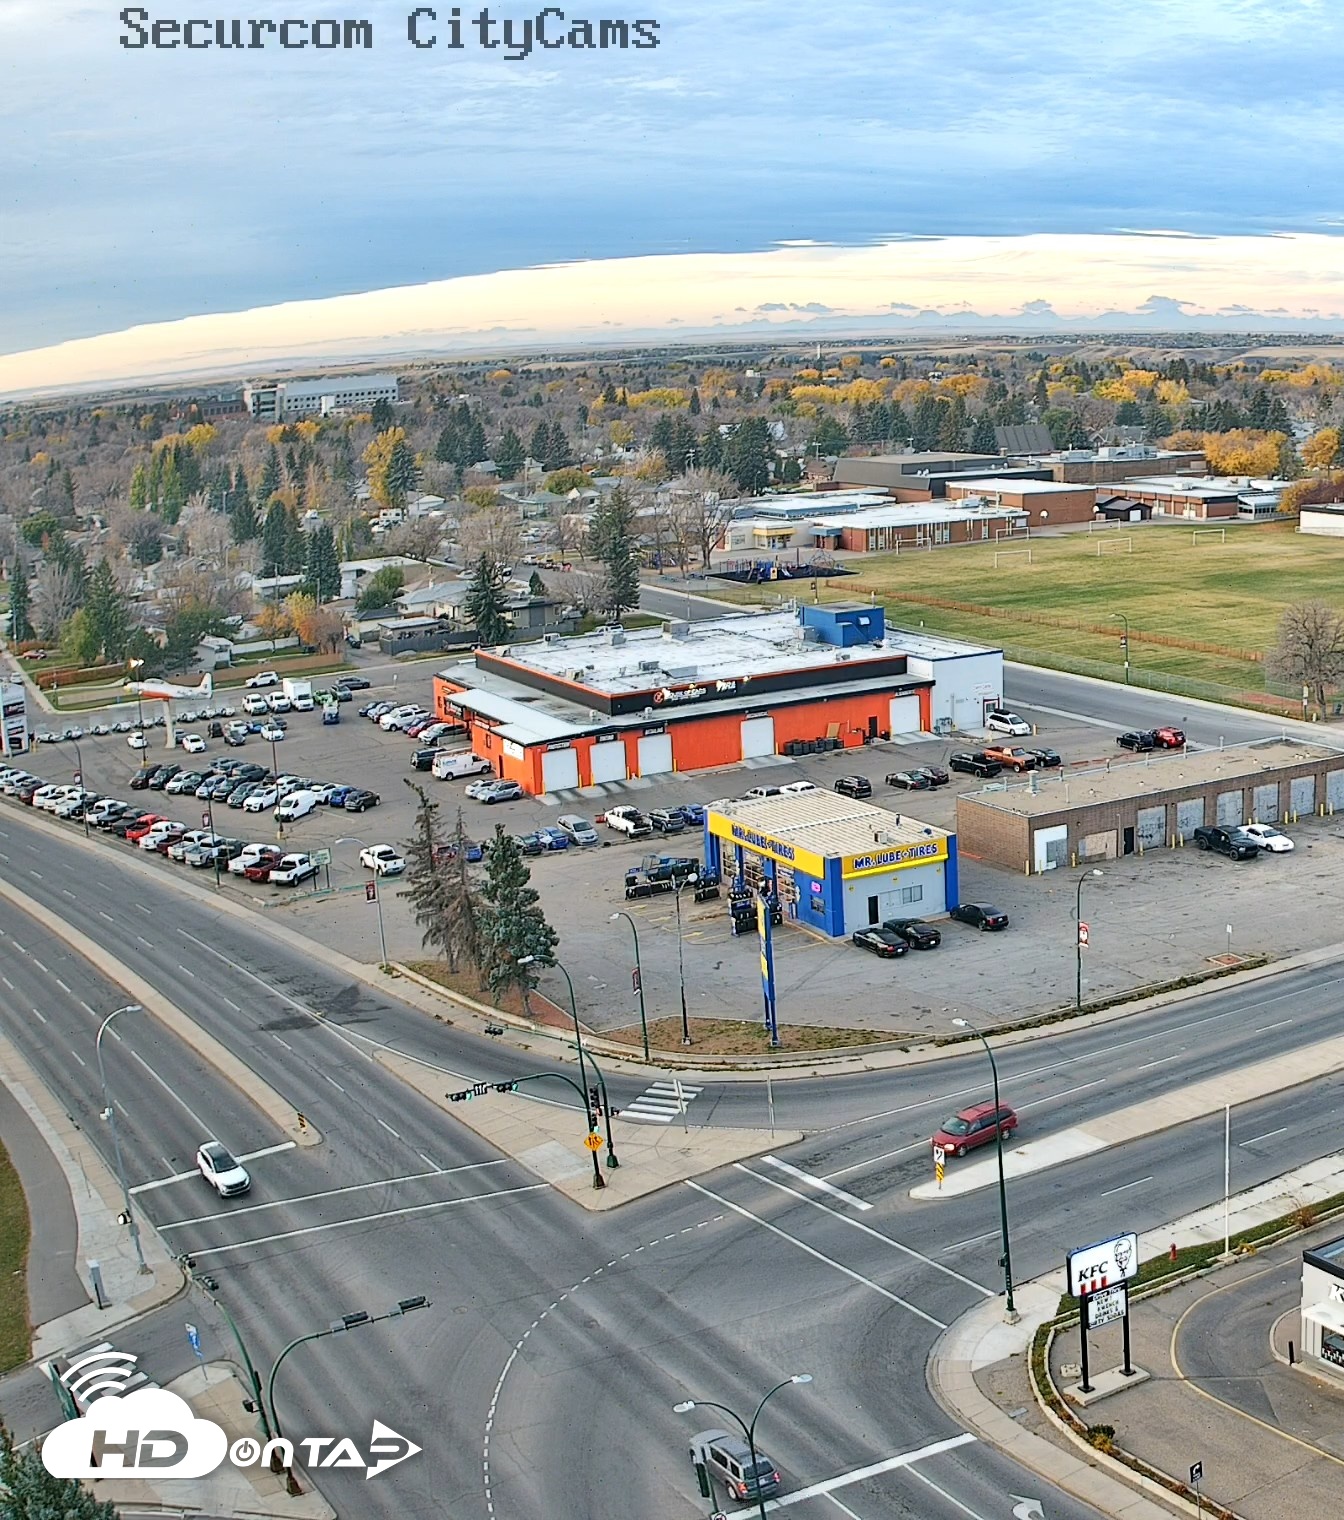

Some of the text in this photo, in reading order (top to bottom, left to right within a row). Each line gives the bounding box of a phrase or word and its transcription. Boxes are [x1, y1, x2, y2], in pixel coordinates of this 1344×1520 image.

[853, 855, 876, 870] MR.
[876, 850, 902, 865] LUBE
[908, 843, 938, 858] TIRES
[1078, 1261, 1109, 1282] KFC
